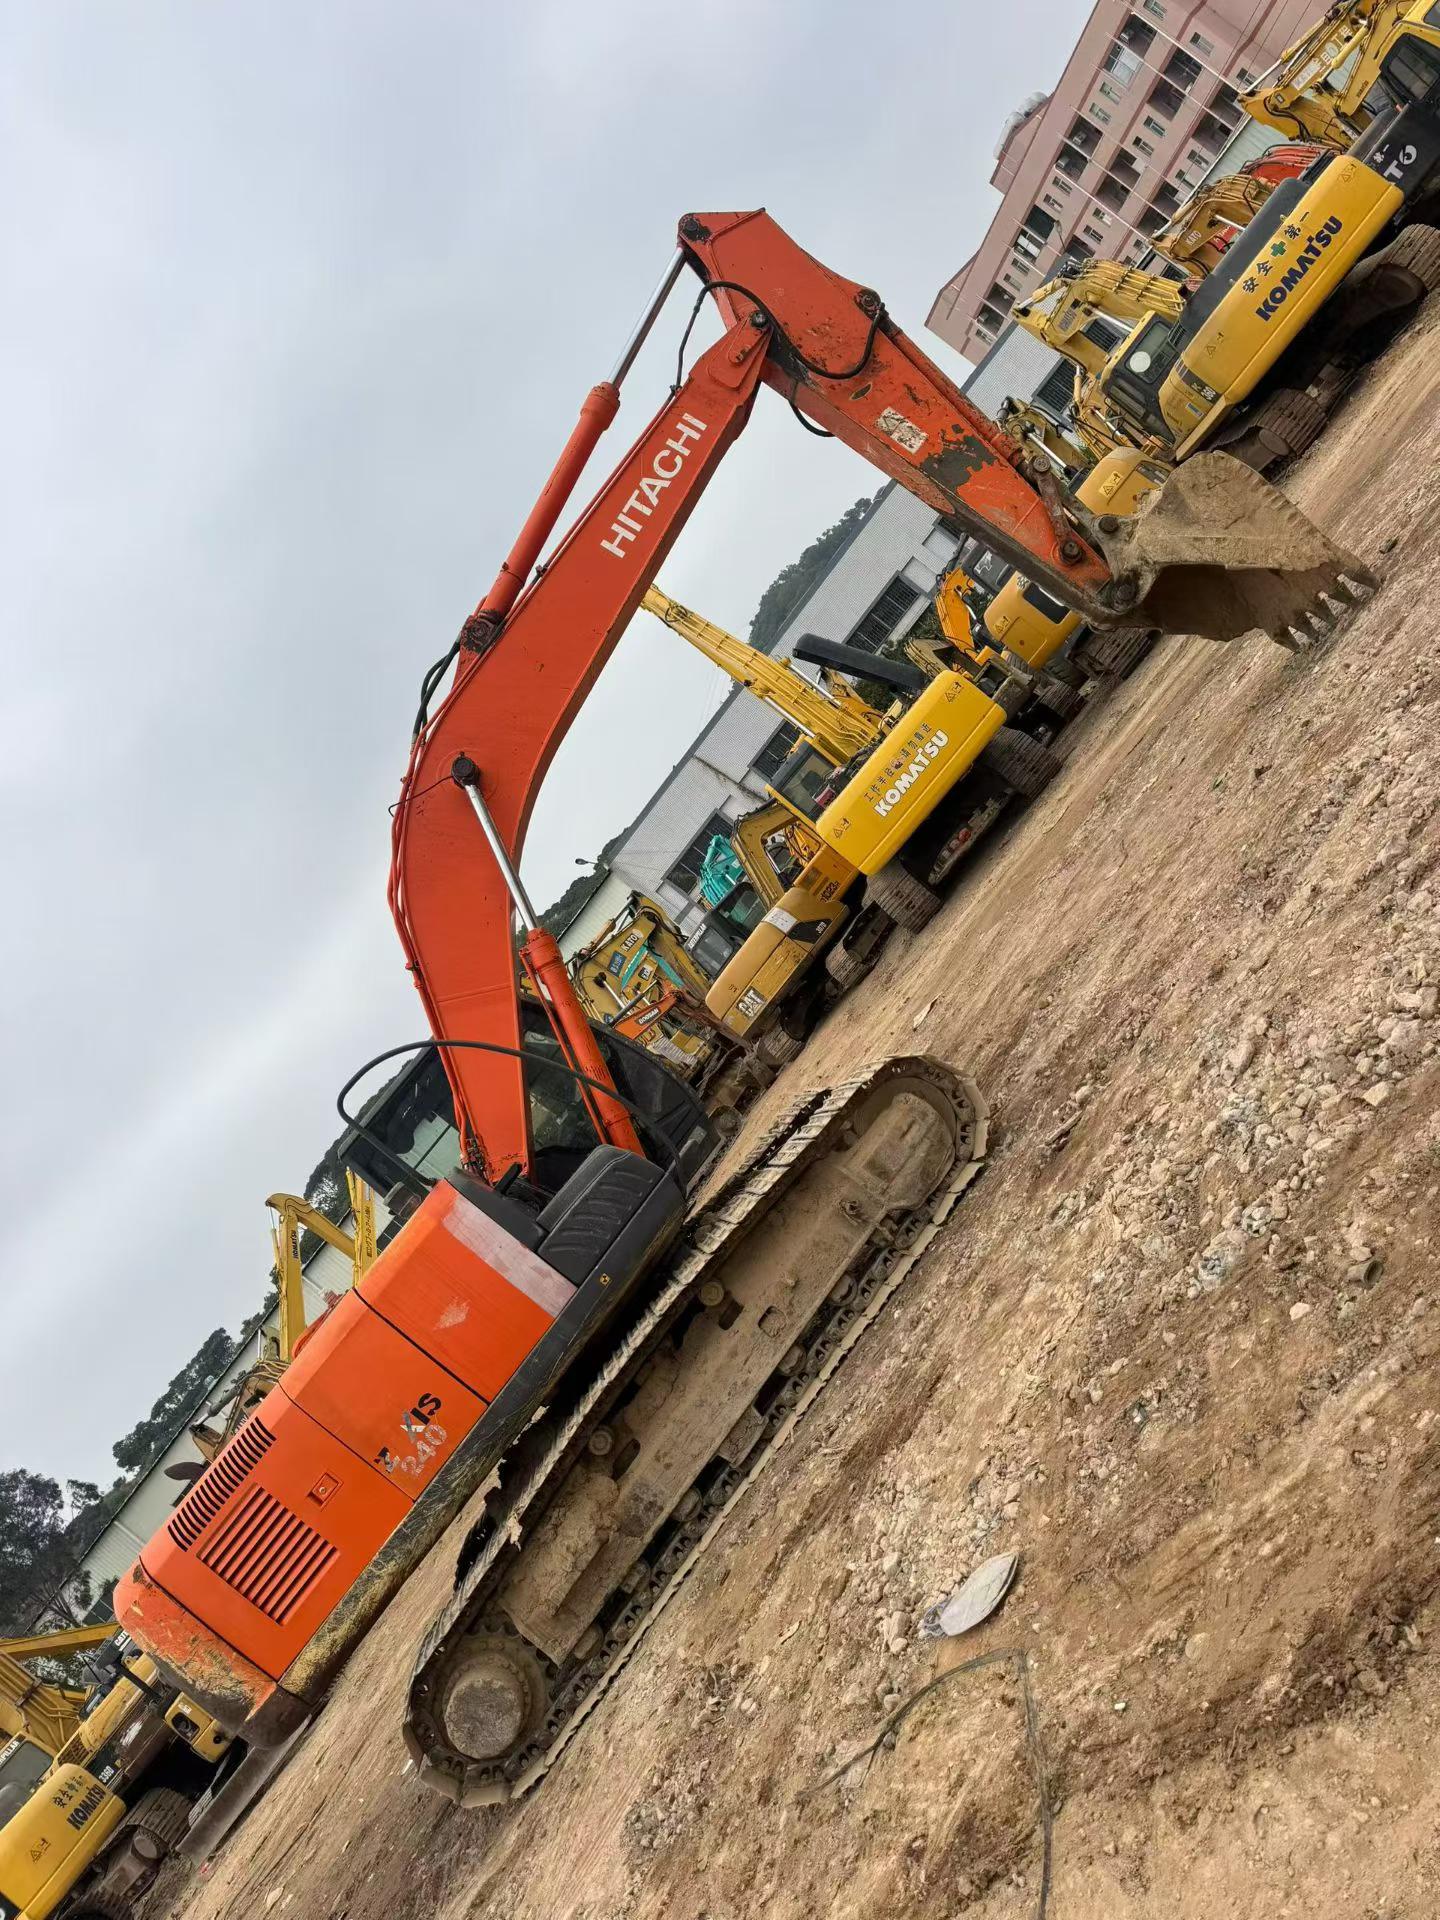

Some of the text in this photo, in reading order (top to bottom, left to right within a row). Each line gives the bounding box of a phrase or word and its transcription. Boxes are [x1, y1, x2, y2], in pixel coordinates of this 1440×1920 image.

[1383, 144, 1418, 181] TO
[1242, 211, 1310, 294] 安全 第一
[1255, 215, 1343, 322] KOMATSU
[600, 412, 708, 559] HITACHI
[873, 728, 949, 817] KOMATSU
[621, 932, 641, 952] KATO
[737, 988, 764, 1018] CAT
[290, 1229, 299, 1260] KOMATSU
[373, 1392, 442, 1474] ZXIS
[400, 1424, 448, 1477] 240
[52, 1788, 74, 1809] 安全
[66, 1783, 107, 1832] KOMATSU
